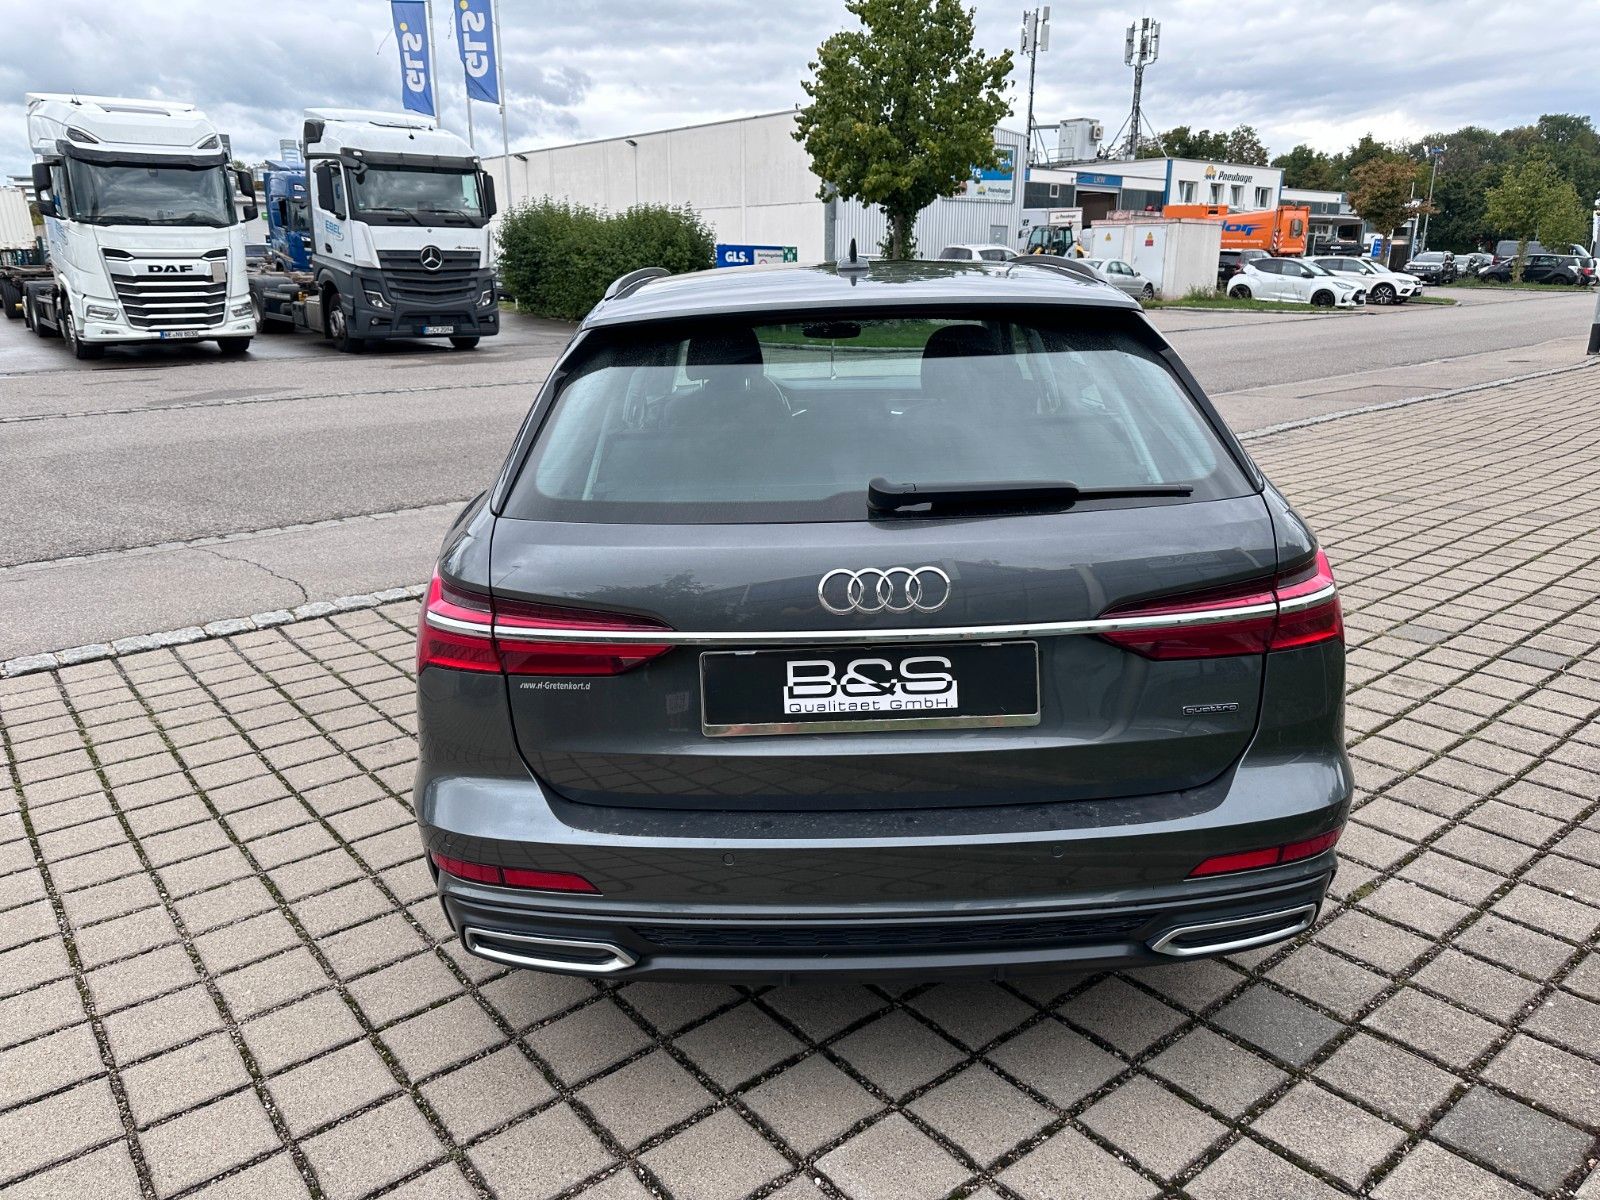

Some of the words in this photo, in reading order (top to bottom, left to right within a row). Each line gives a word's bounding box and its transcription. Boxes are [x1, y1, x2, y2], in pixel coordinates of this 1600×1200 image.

[1218, 170, 1253, 184] Pneuhage
[147, 264, 194, 273] DAF
[786, 655, 953, 700] B&S
[788, 699, 881, 713] Qualitaet
[1184, 703, 1238, 715] quattro
